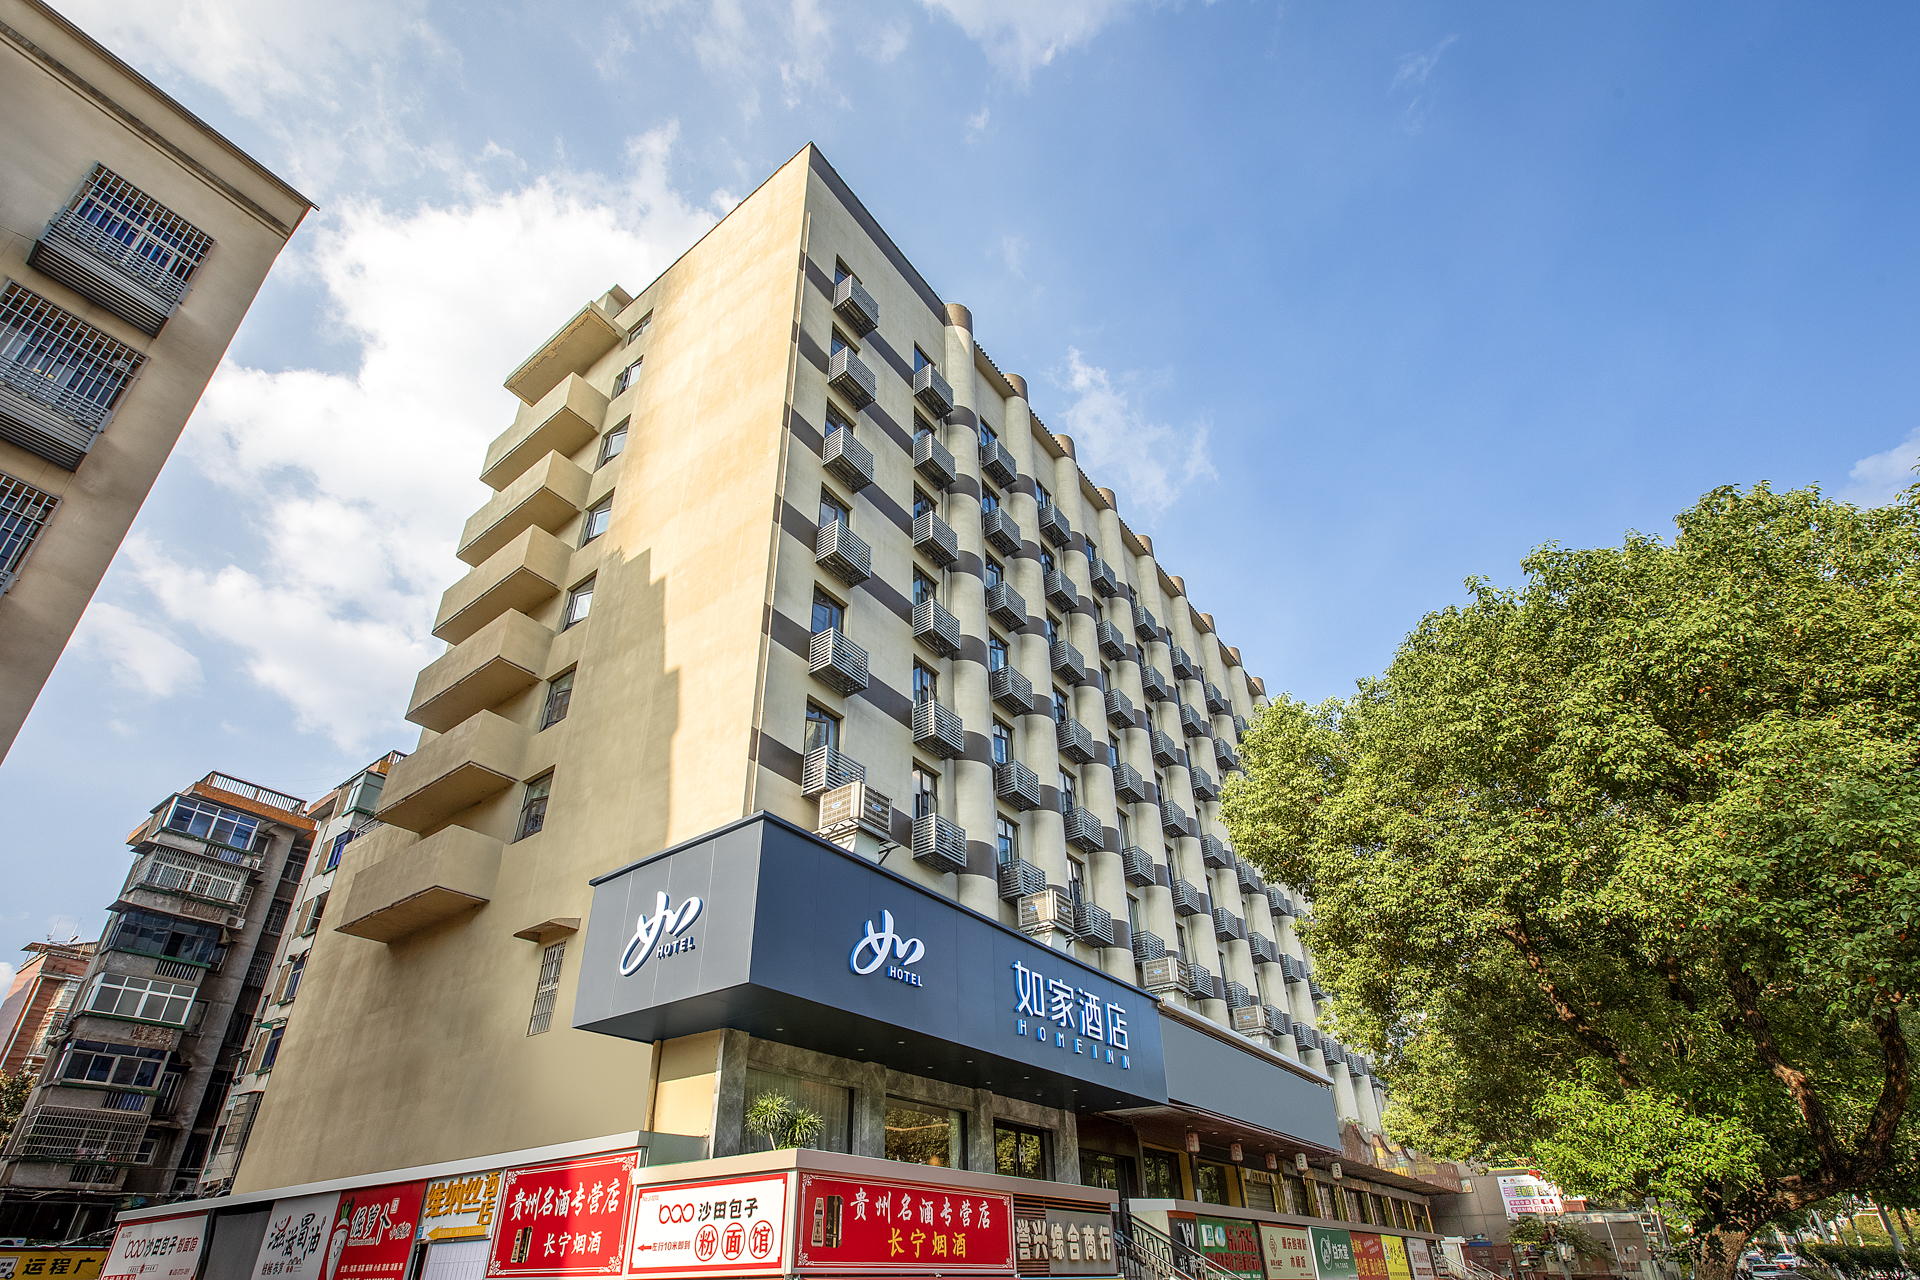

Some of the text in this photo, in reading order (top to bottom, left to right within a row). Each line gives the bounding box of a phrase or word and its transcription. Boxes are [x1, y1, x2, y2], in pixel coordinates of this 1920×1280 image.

[656, 935, 696, 960] HOTEL
[887, 965, 923, 988] HOTEL
[1012, 960, 1129, 1051] 如家酒店
[423, 1176, 484, 1219] 维纳丝
[509, 1178, 621, 1221] 贵州名酒专营店
[698, 1197, 759, 1222] 沙田包子
[850, 1186, 991, 1229] 贵州名酒专营店
[143, 1235, 179, 1258] 沙田包子
[543, 1230, 602, 1258] 长宁烟酒
[698, 1225, 771, 1257] 粉面馆
[888, 1227, 966, 1258] 长宁烟酒
[1016, 1219, 1111, 1260] 誉兴综合商行
